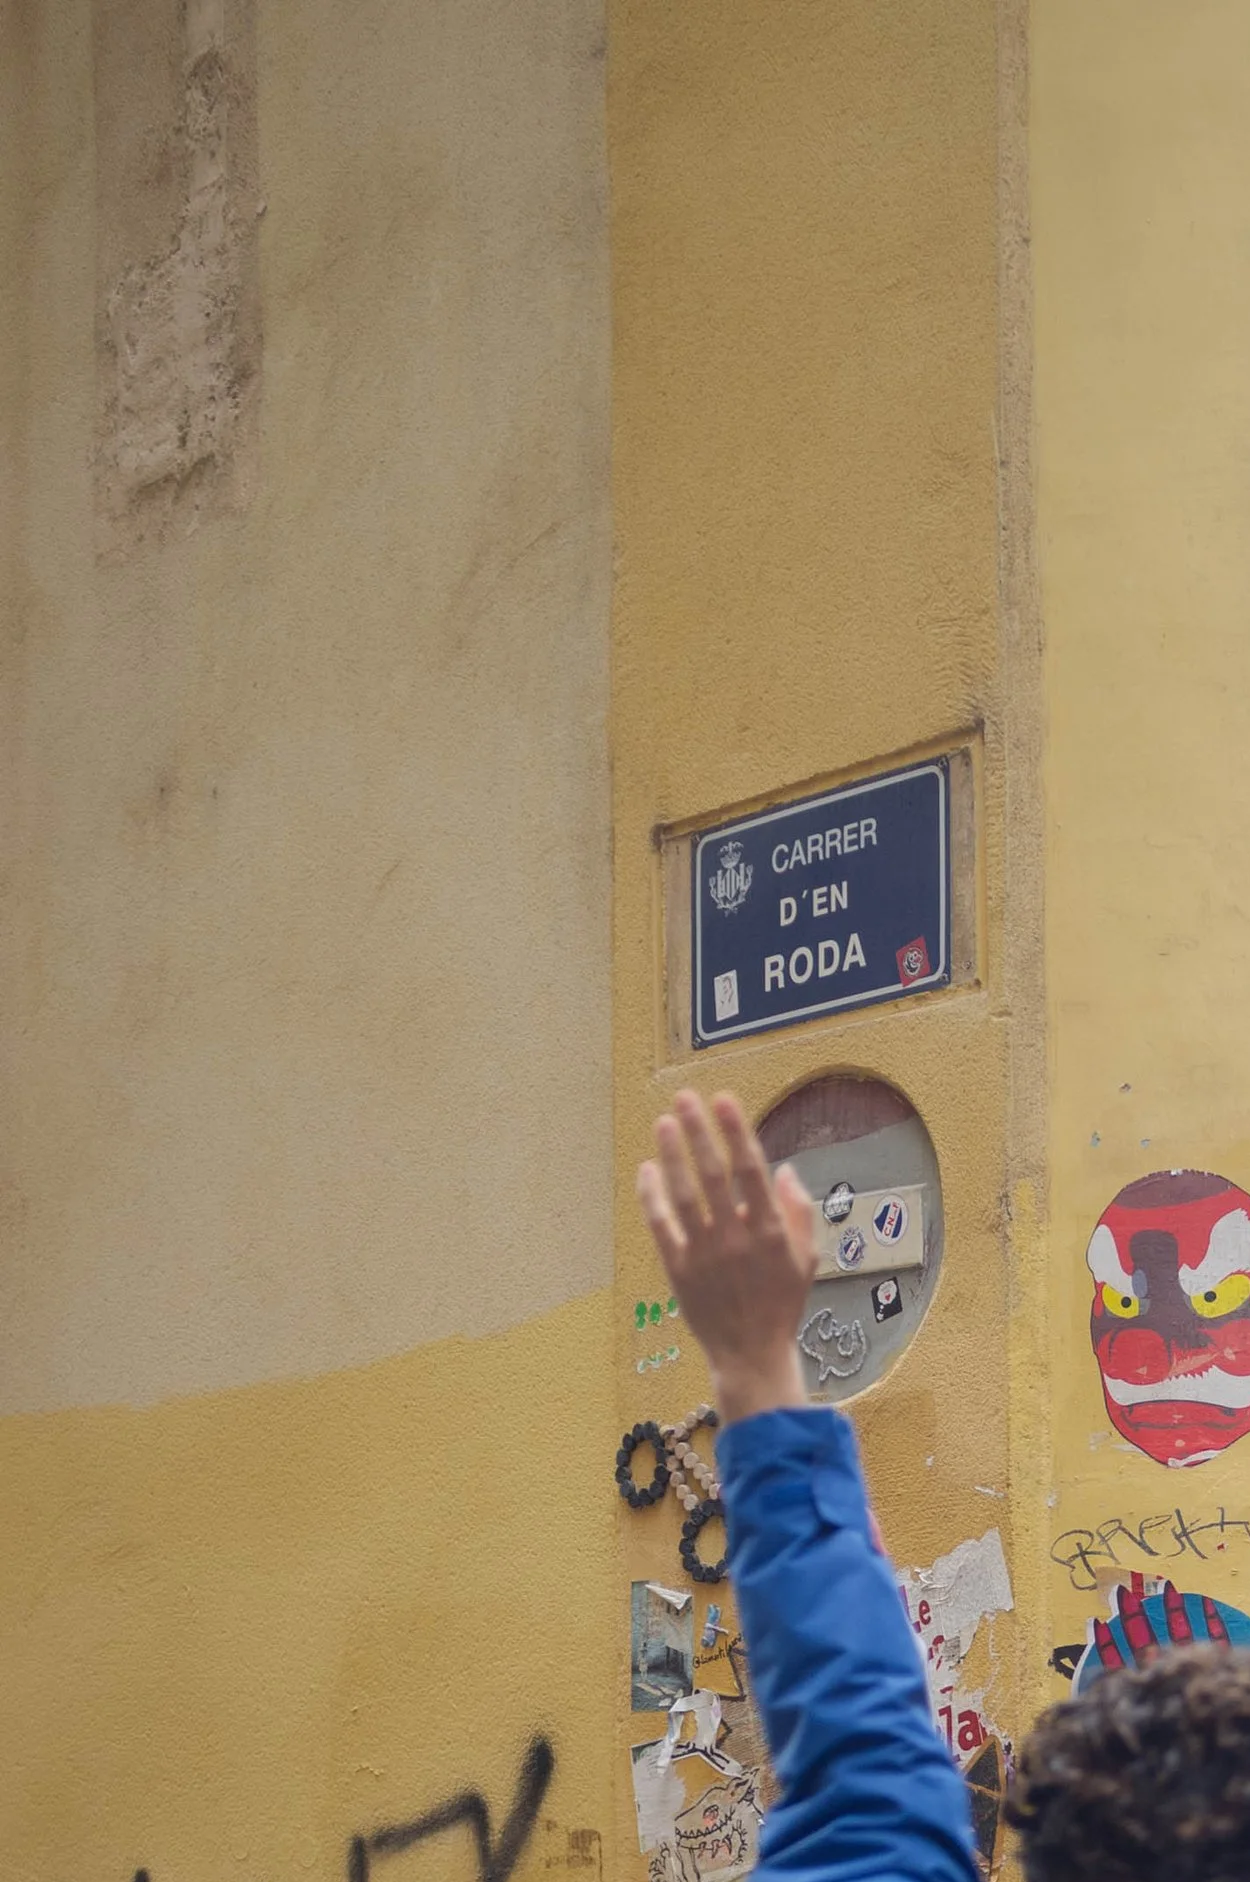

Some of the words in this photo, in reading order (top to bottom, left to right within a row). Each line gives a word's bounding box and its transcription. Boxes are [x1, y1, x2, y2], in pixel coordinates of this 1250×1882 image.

[771, 818, 878, 873] CARRER
[779, 881, 849, 927] D'EN
[764, 933, 866, 992] RODA
